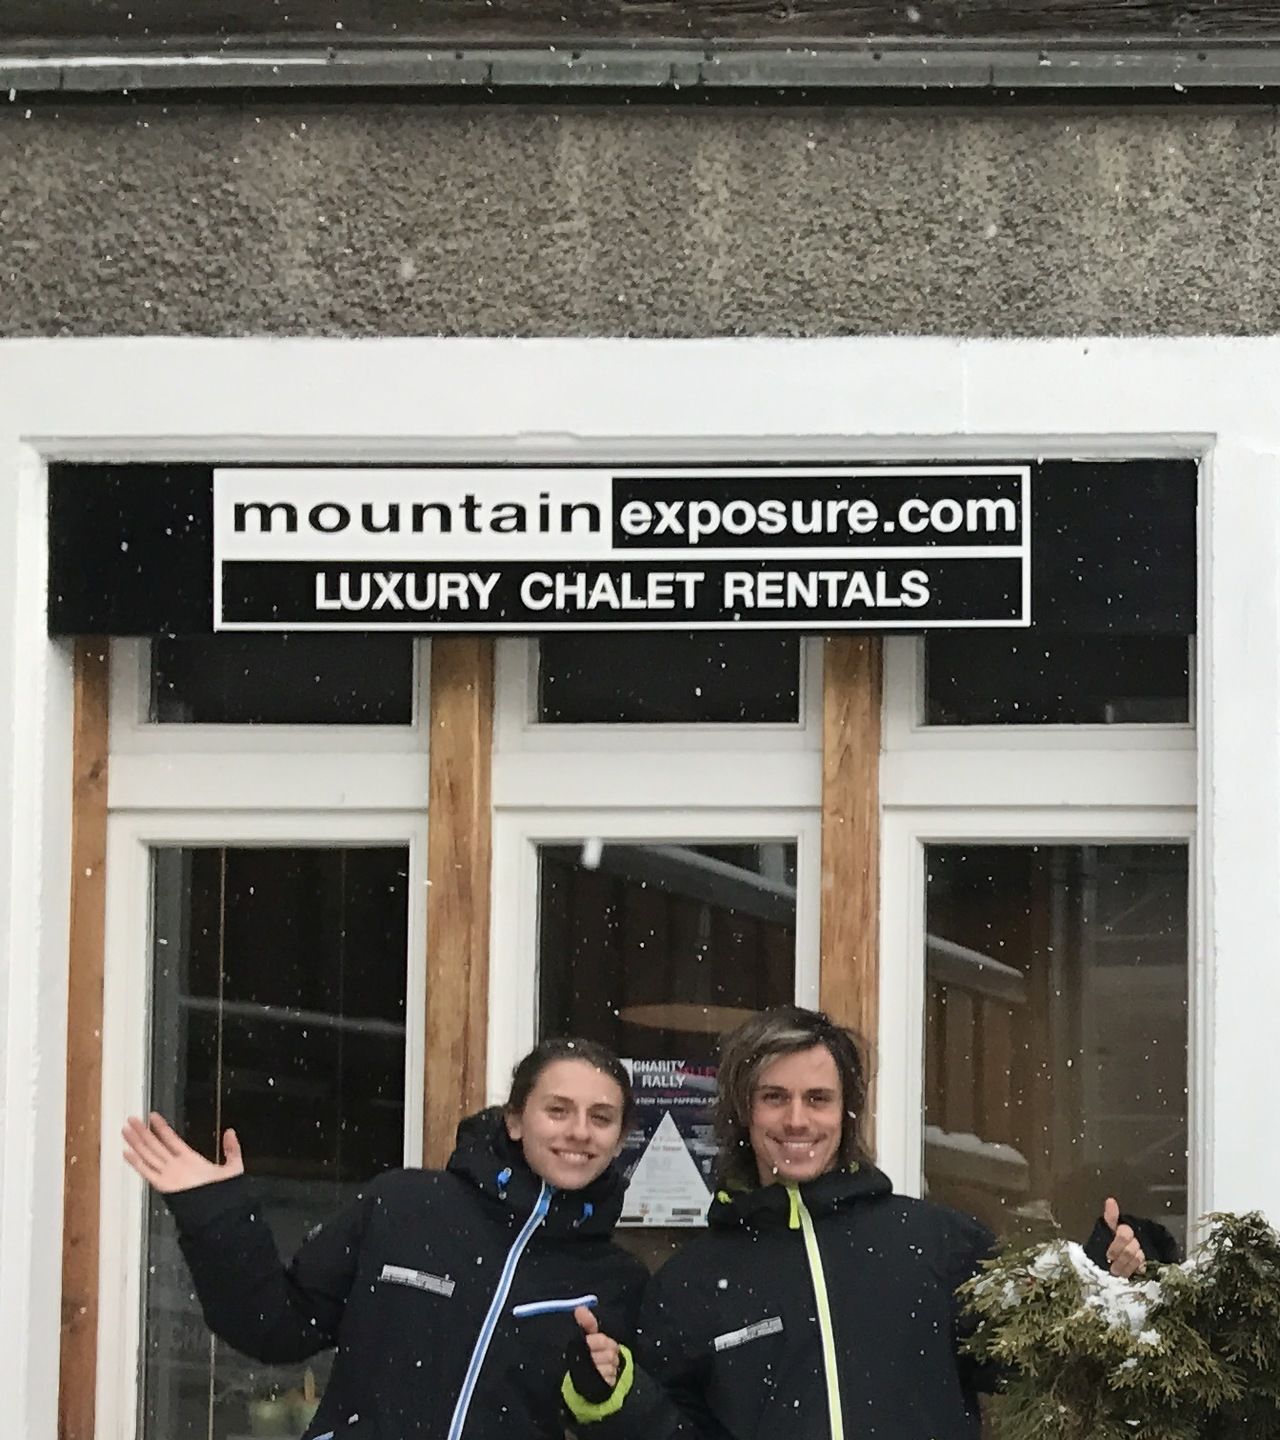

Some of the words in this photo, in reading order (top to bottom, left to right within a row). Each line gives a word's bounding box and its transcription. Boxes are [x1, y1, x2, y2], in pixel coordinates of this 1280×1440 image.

[233, 491, 602, 534] mountain
[619, 498, 1017, 545] exposure.com
[315, 571, 502, 611] LUXURY
[520, 570, 705, 611] CHALET
[723, 569, 931, 610] RENTALS
[633, 1060, 686, 1073] CHARITY
[642, 1074, 686, 1088] RALLY
